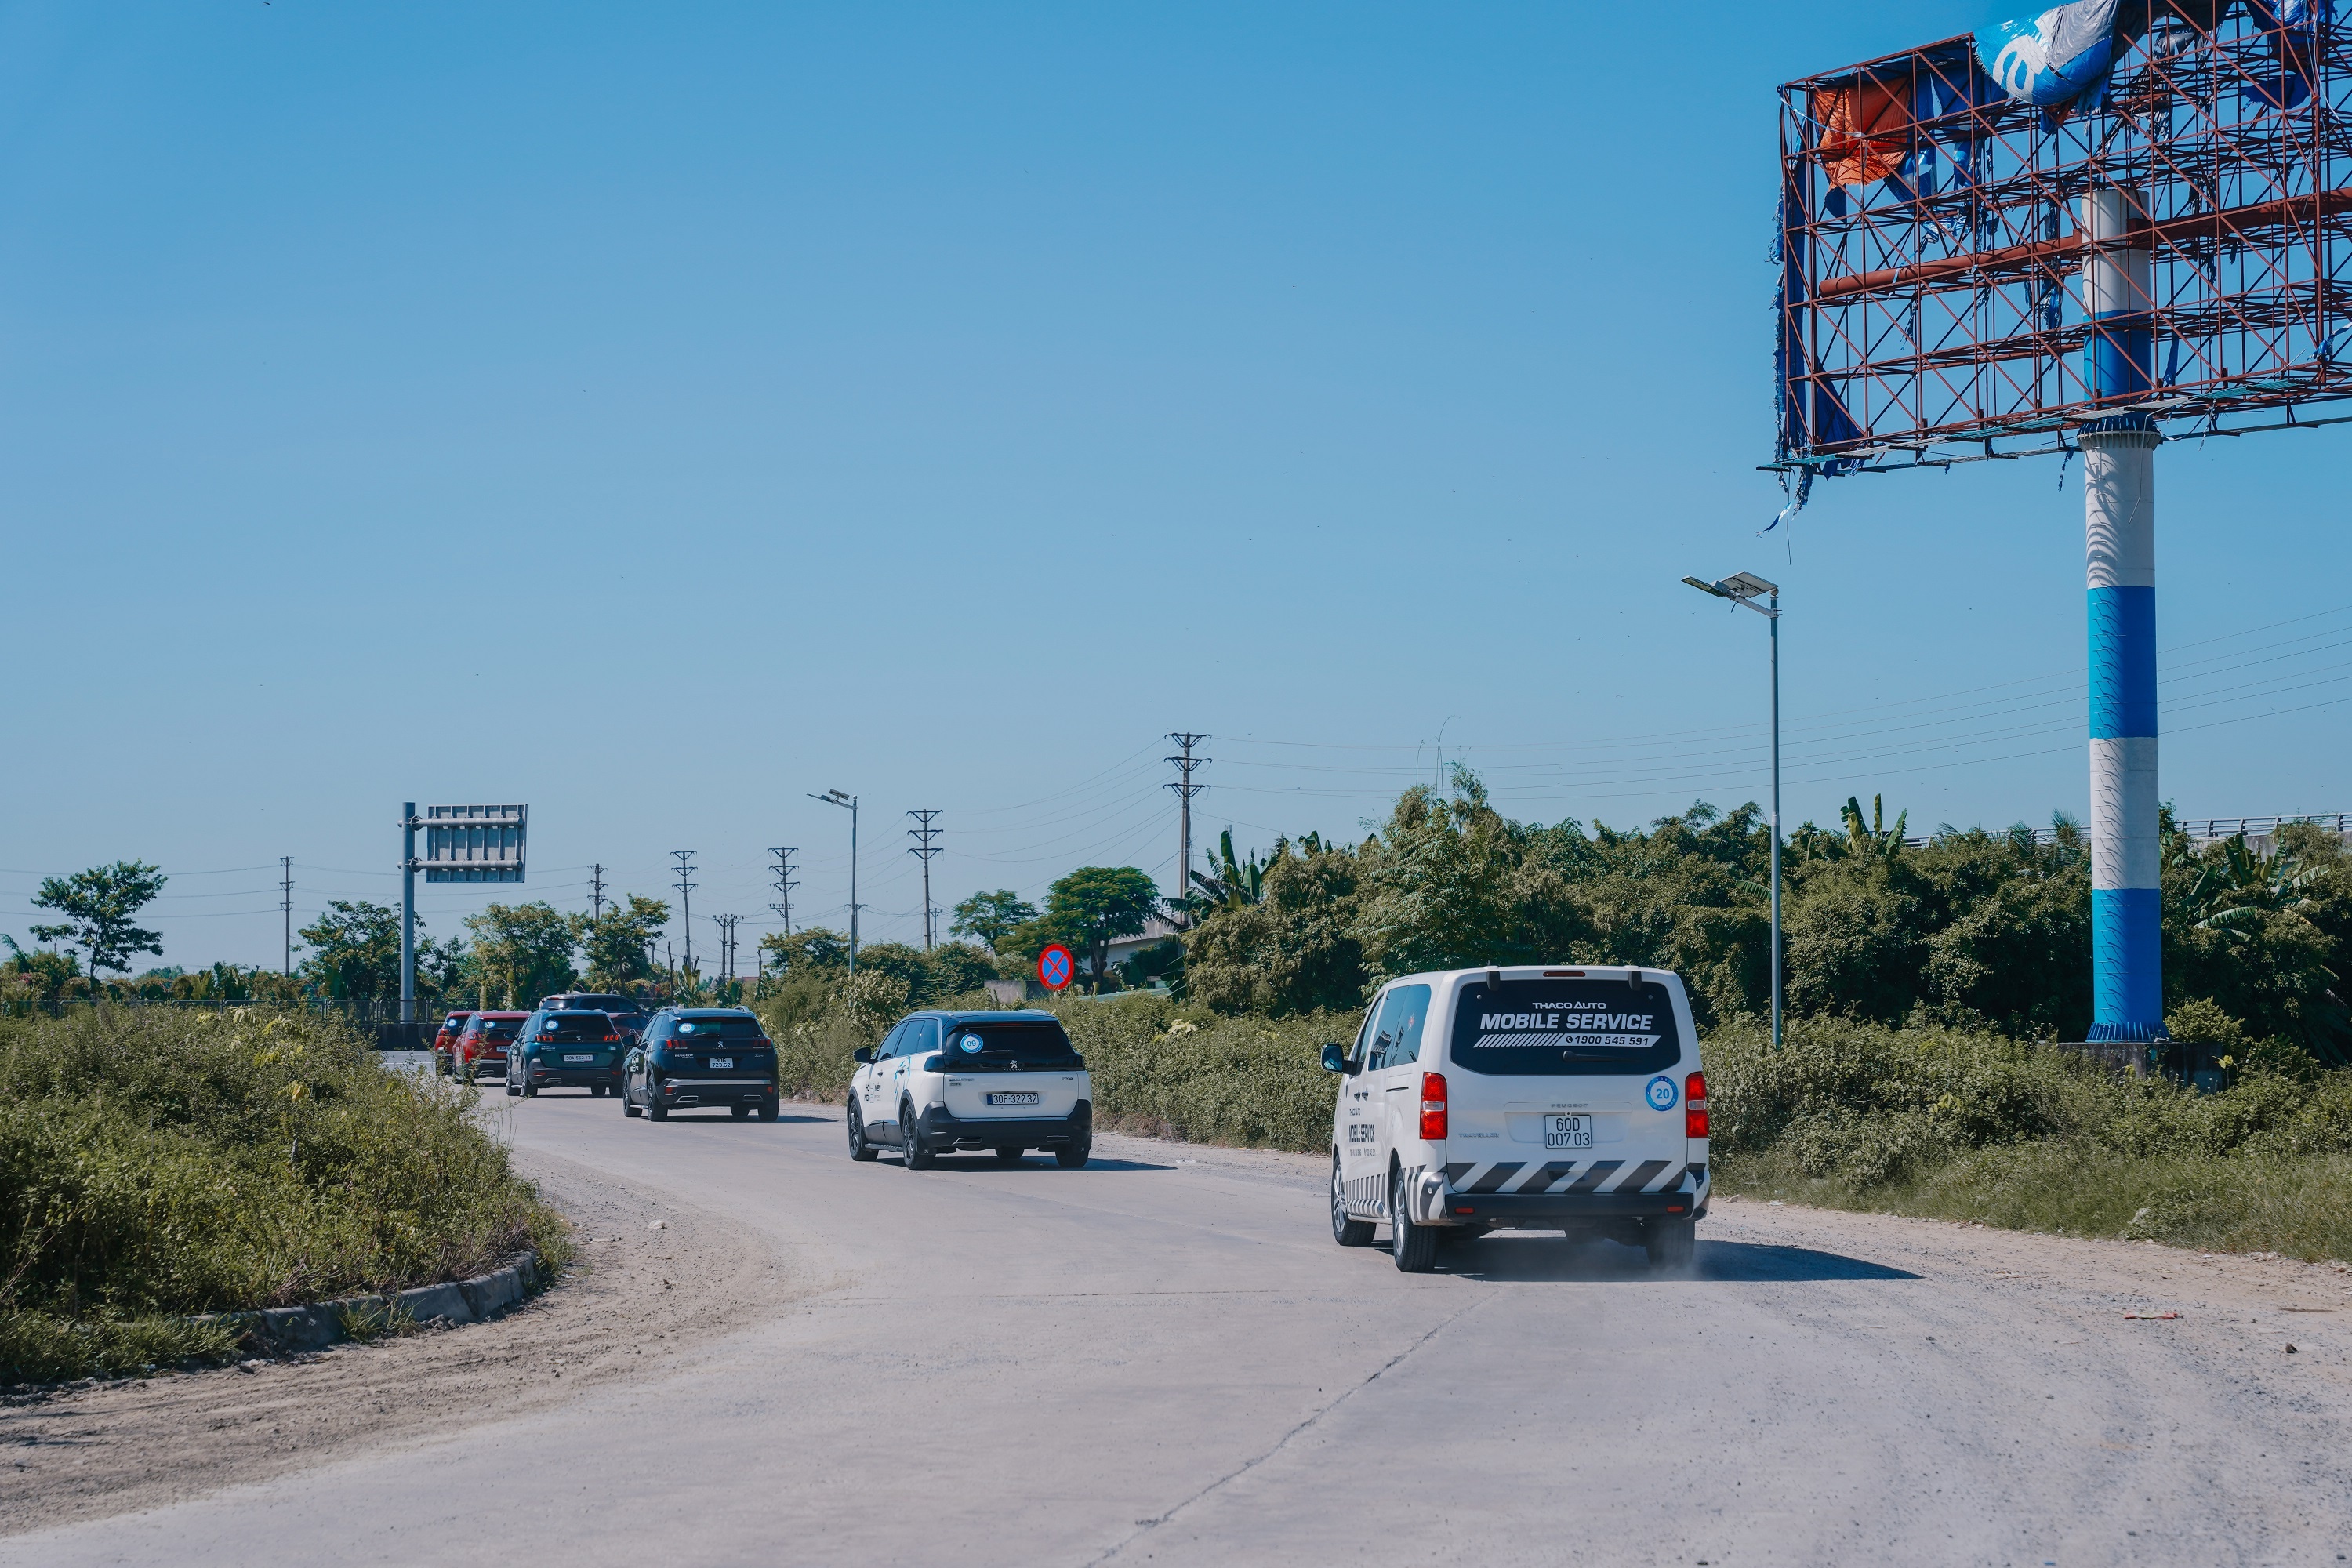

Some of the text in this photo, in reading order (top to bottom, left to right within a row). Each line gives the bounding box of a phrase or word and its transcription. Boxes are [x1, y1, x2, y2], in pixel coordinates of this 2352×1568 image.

[1573, 1001, 1606, 1010] AUTO
[1479, 1013, 1653, 1031] MOBILE SERVICE
[1574, 1036, 1649, 1046] 1900 545 591
[993, 1094, 1037, 1104] 30F-322.32
[1655, 1088, 1670, 1099] 20
[1555, 1117, 1581, 1131] 60D
[1547, 1132, 1591, 1146] 007.03
